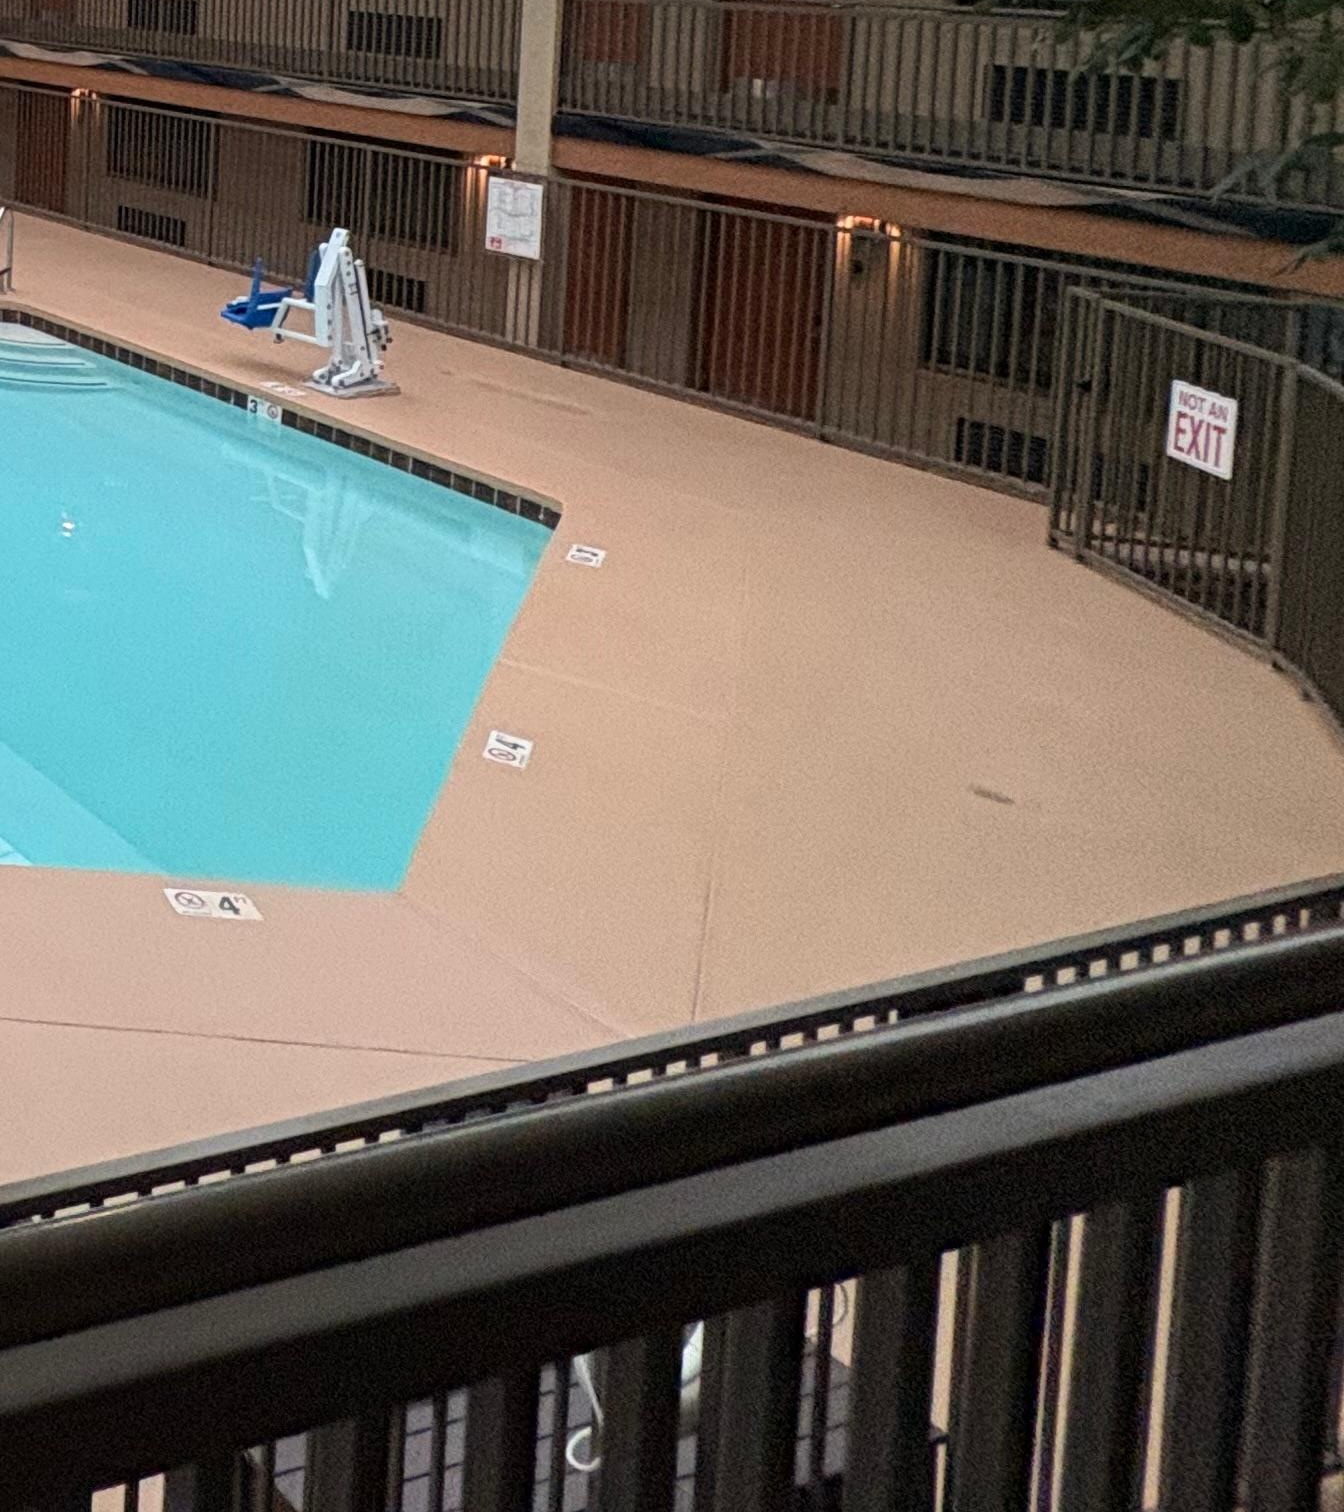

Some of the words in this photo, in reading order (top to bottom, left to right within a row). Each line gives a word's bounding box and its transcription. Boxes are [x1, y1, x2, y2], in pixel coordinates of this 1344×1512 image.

[249, 399, 258, 413] 3
[1178, 390, 1205, 411] NOT
[1208, 401, 1229, 423] AN
[1173, 411, 1226, 467] EXIT
[218, 896, 240, 915] 4
